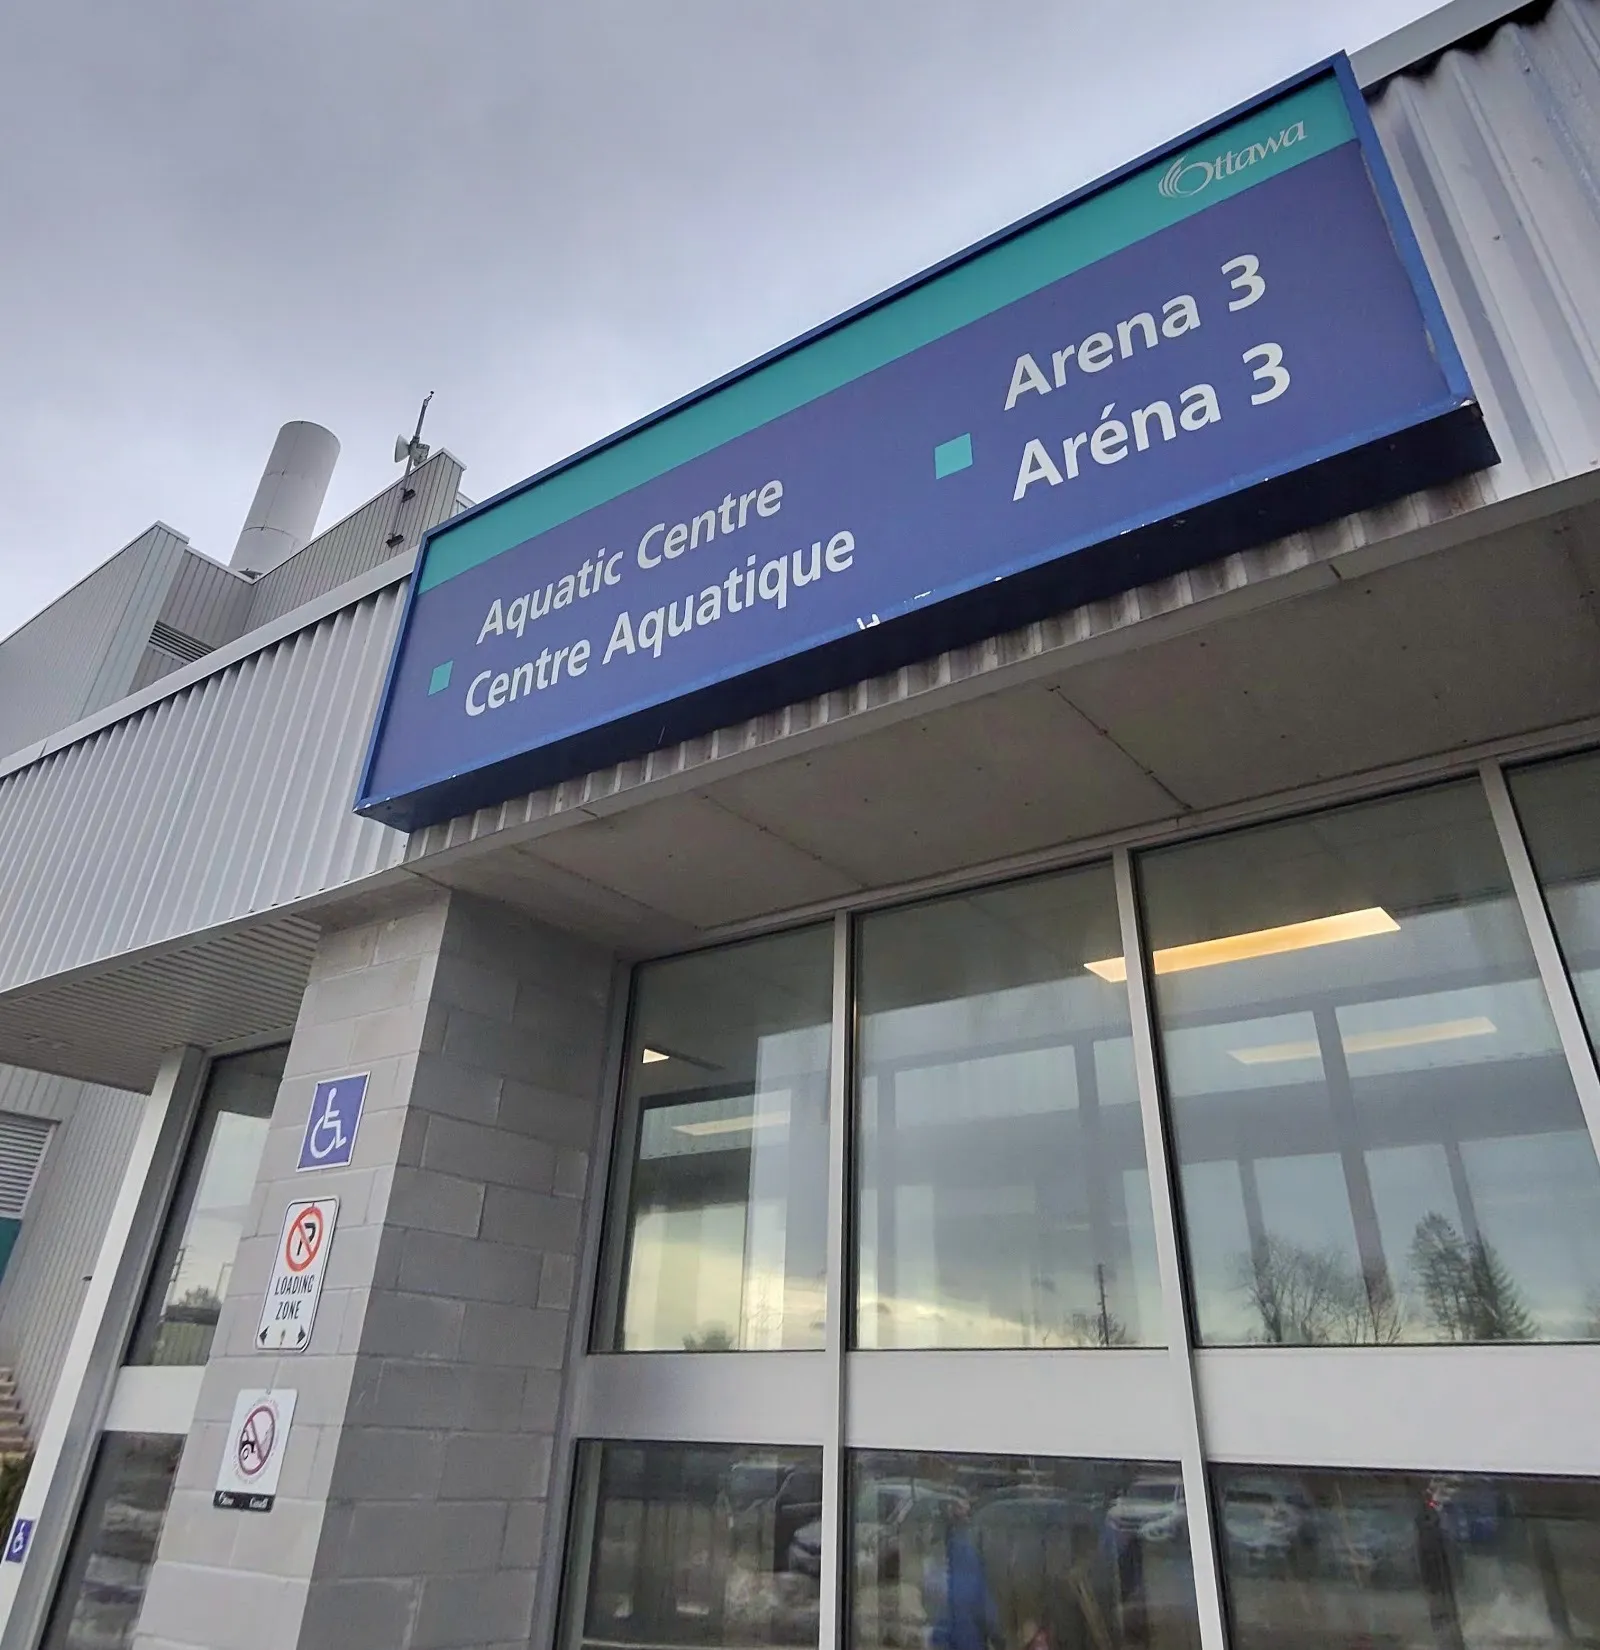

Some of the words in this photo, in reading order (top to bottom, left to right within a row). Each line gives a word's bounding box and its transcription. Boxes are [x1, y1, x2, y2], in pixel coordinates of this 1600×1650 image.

[1158, 119, 1308, 199] Ottawa
[1004, 294, 1201, 411] Arena
[1221, 254, 1266, 312] 3
[1012, 383, 1222, 502] Aréna
[1242, 342, 1291, 406] 3
[465, 638, 591, 717] Centre
[602, 530, 855, 658] Aquatique
[475, 547, 624, 645] Aquatic
[637, 479, 784, 570] Centre
[274, 1274, 315, 1296] LOADING
[275, 1300, 301, 1320] ZONE
